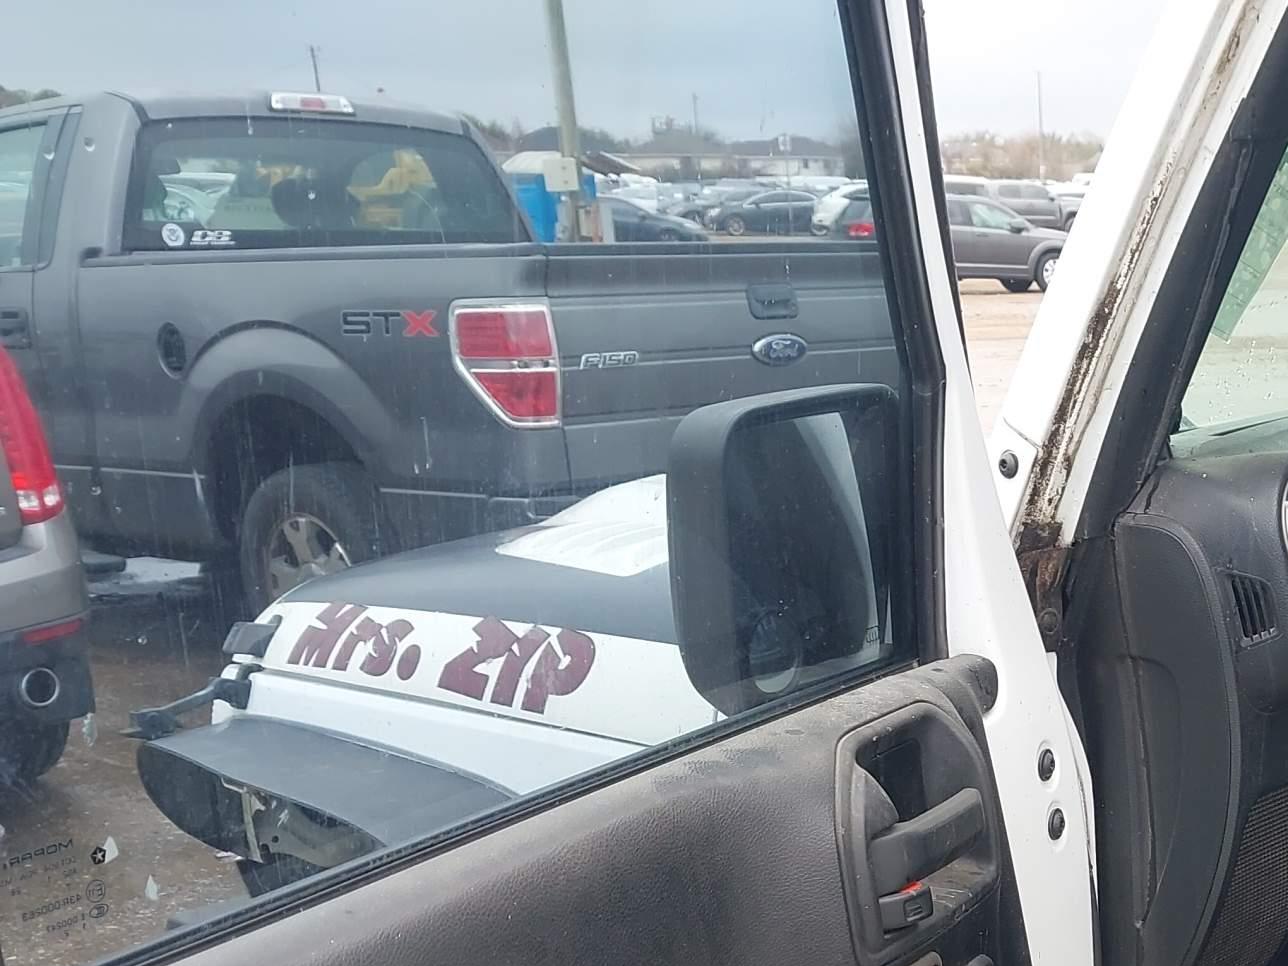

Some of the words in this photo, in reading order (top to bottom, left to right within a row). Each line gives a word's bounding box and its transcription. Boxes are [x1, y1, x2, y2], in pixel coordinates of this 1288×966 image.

[341, 309, 438, 337] STX
[770, 340, 799, 360] Ford
[286, 601, 422, 681] Mrs.
